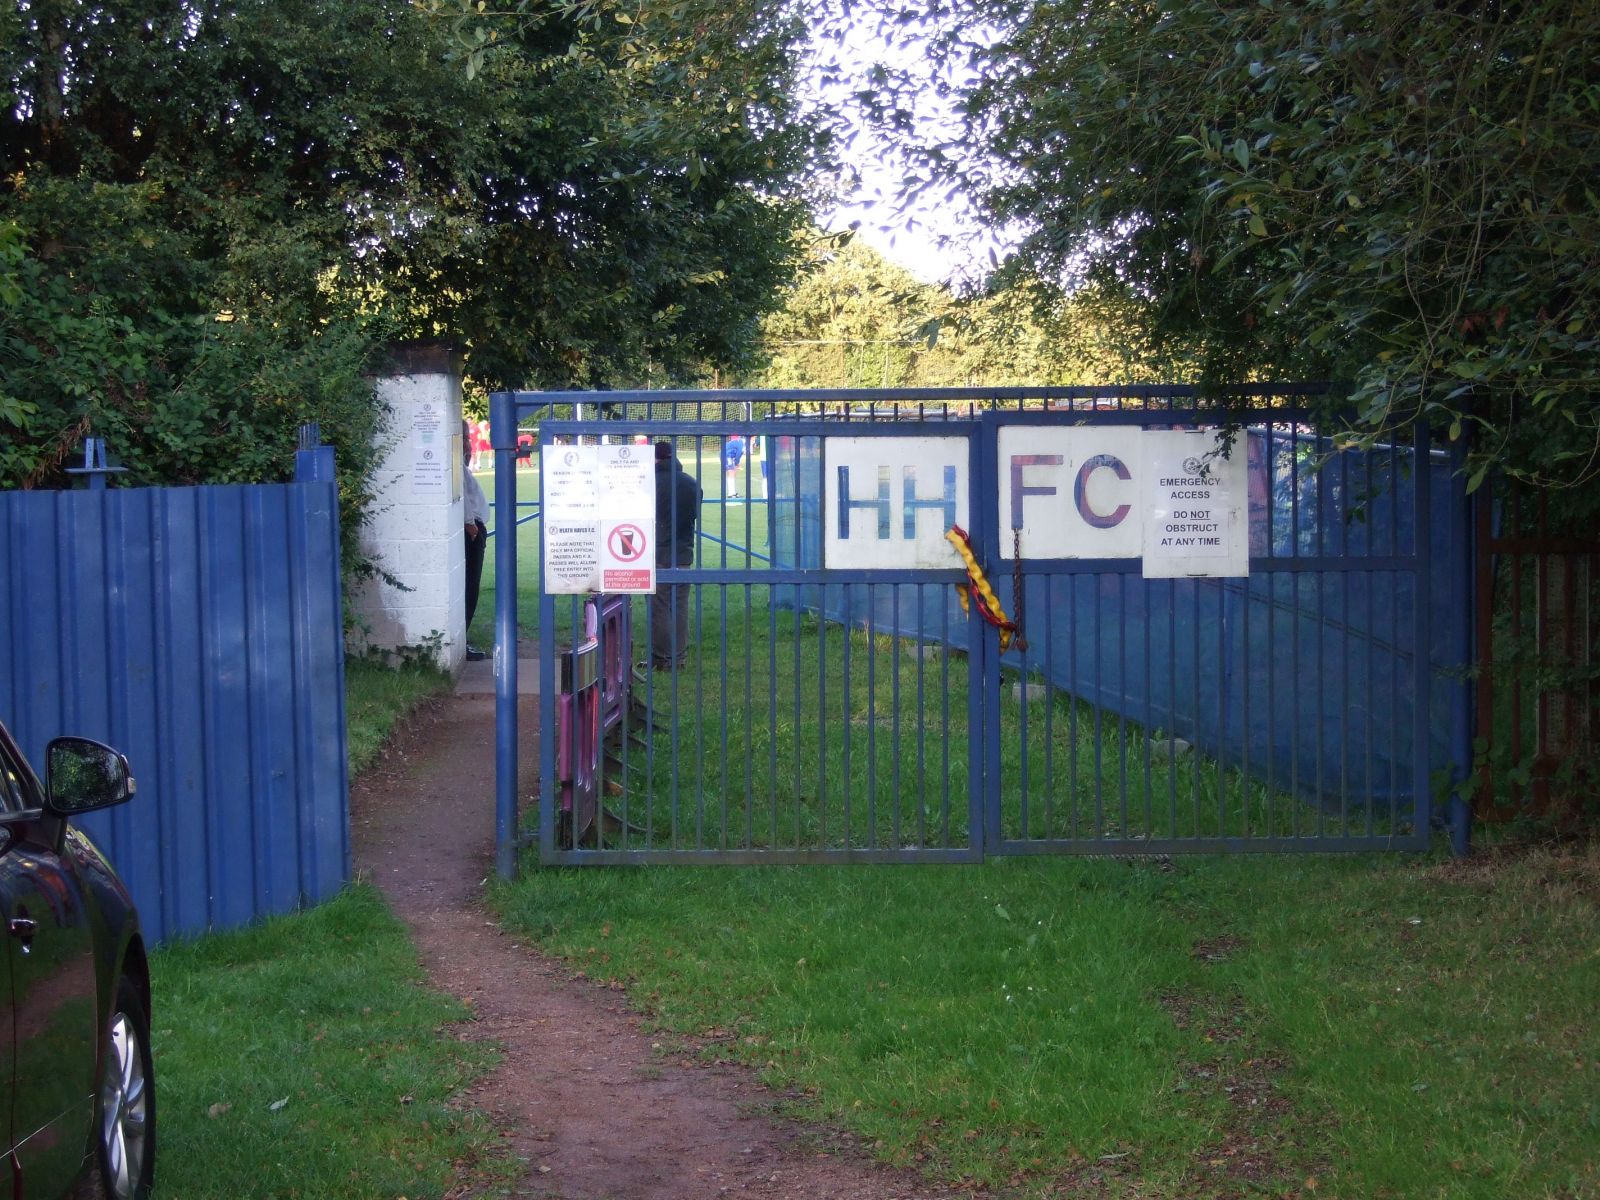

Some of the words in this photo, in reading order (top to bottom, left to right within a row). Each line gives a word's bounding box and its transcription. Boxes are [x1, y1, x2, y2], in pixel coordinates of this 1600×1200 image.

[1160, 478, 1220, 486] EMERGENCY
[838, 465, 956, 539] HH
[1011, 454, 1132, 529] FC
[1171, 491, 1210, 499] ACCESS
[1190, 511, 1210, 519] NOT
[1165, 524, 1218, 532] OBSTRUCT
